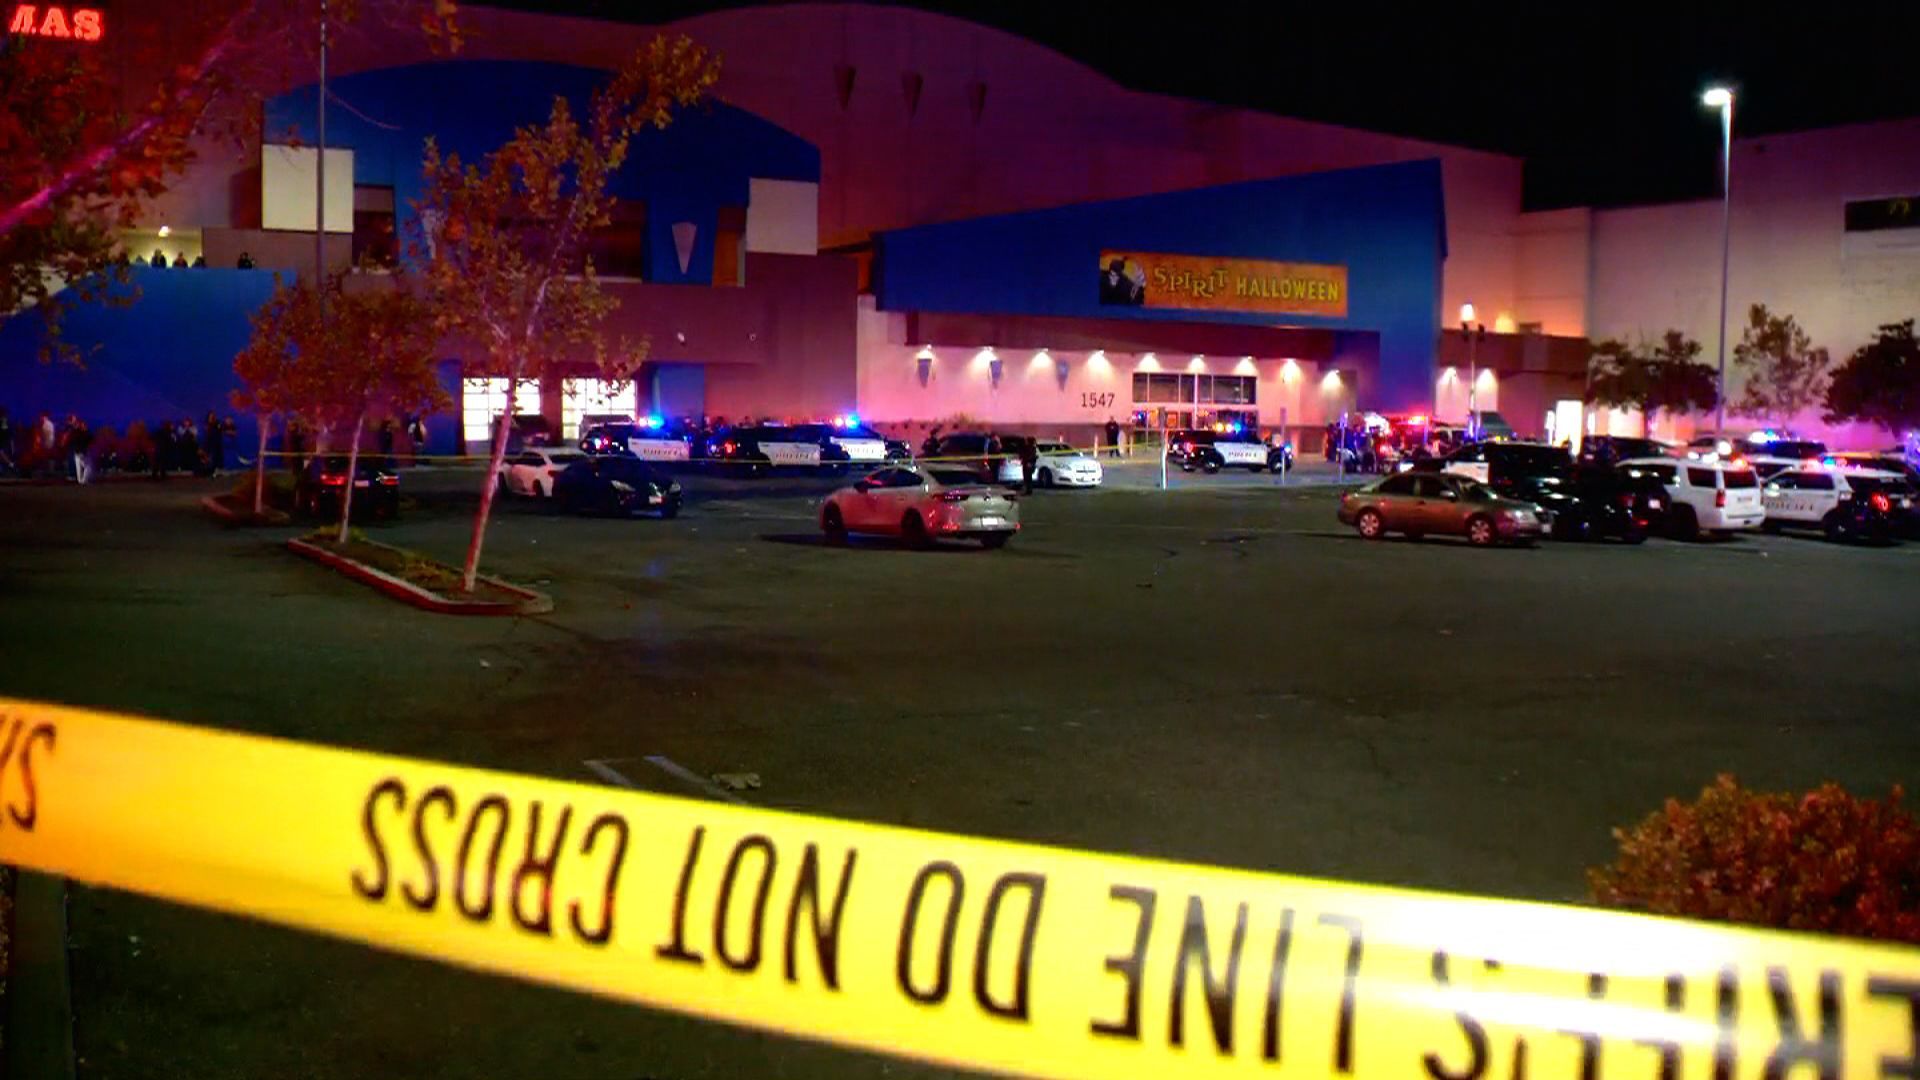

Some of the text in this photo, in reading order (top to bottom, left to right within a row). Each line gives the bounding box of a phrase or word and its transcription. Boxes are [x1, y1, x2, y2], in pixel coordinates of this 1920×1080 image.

[1153, 267, 1339, 300] SPIRIT HALLOWEEN
[1081, 392, 1115, 408] 1547
[351, 777, 630, 945] CROSS
[654, 825, 858, 991] NOT
[895, 860, 1048, 1023] DO
[1088, 883, 1363, 1074] LINE
